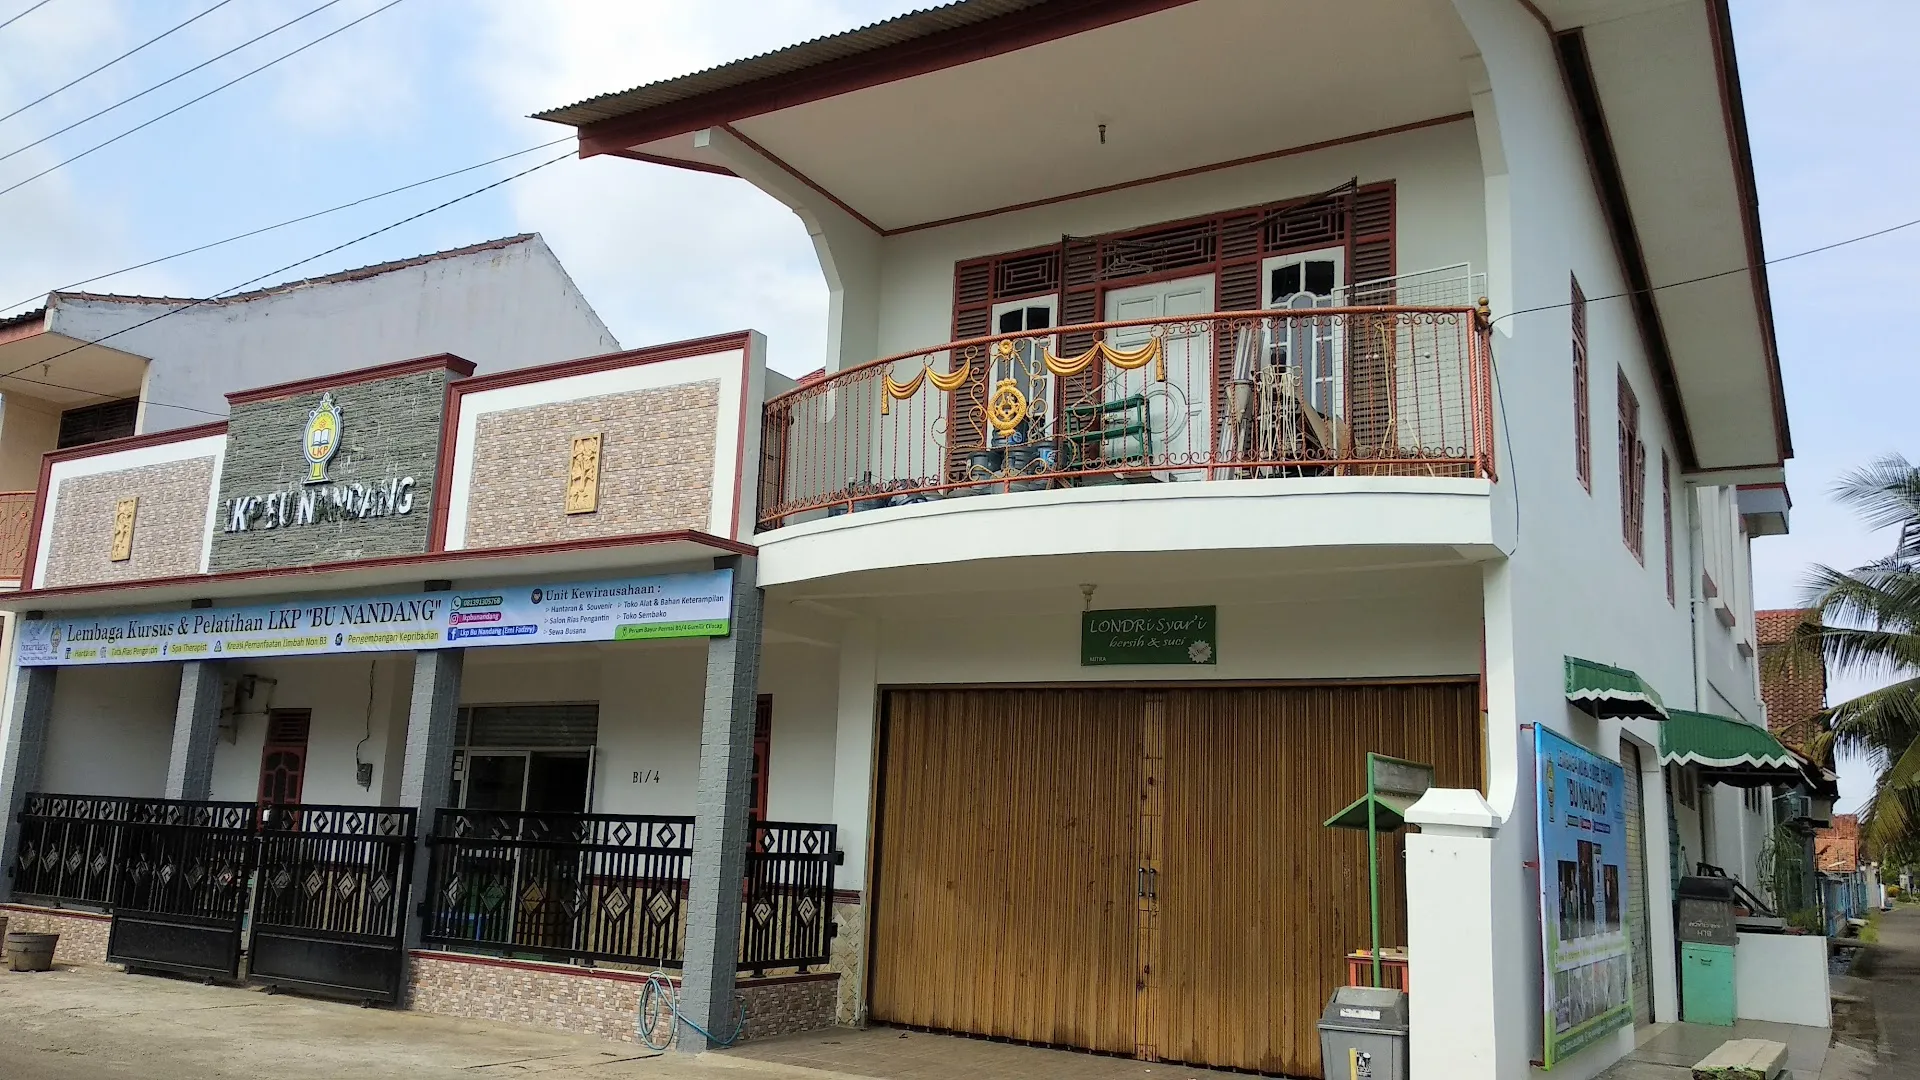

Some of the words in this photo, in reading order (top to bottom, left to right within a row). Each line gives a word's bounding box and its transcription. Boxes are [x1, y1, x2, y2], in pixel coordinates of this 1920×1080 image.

[312, 445, 329, 457] LKP
[297, 475, 415, 527] NANDANG
[546, 588, 568, 601] Unit
[571, 584, 655, 600] Kewirausahaan
[551, 605, 577, 613] Hantaran
[587, 602, 612, 611] Souvenir
[624, 600, 638, 608] Toko
[639, 599, 652, 607] Alat
[653, 598, 659, 606] &
[660, 597, 680, 606] Bahan
[682, 595, 724, 605] Keterampilan
[67, 622, 123, 643] Lembaga
[127, 620, 174, 639] Kursus
[178, 616, 189, 635] &
[193, 612, 263, 634] Pelatihan
[268, 609, 302, 630] LKP
[306, 605, 336, 628] "BU
[340, 599, 441, 625] NANDANG"
[549, 617, 565, 625] Salon
[567, 616, 579, 624] Rias
[580, 614, 609, 624] Pengantin
[623, 612, 637, 620] Toko
[638, 610, 667, 619] Sembako
[479, 627, 501, 636] Nandang
[548, 628, 564, 636] Sewa
[565, 628, 586, 636] Busana
[172, 645, 181, 653] Spa
[183, 643, 207, 653] Therapist
[227, 642, 244, 650] Kreasi
[245, 640, 281, 649] Pemanfaatan
[283, 638, 305, 647] Limbah
[306, 637, 318, 646] Non
[319, 636, 327, 645] B3
[348, 632, 398, 645] Pengembangan
[400, 631, 439, 643] Kepribadian
[1109, 635, 1144, 648] bersih
[1147, 637, 1160, 648] &
[1162, 636, 1186, 647] suci
